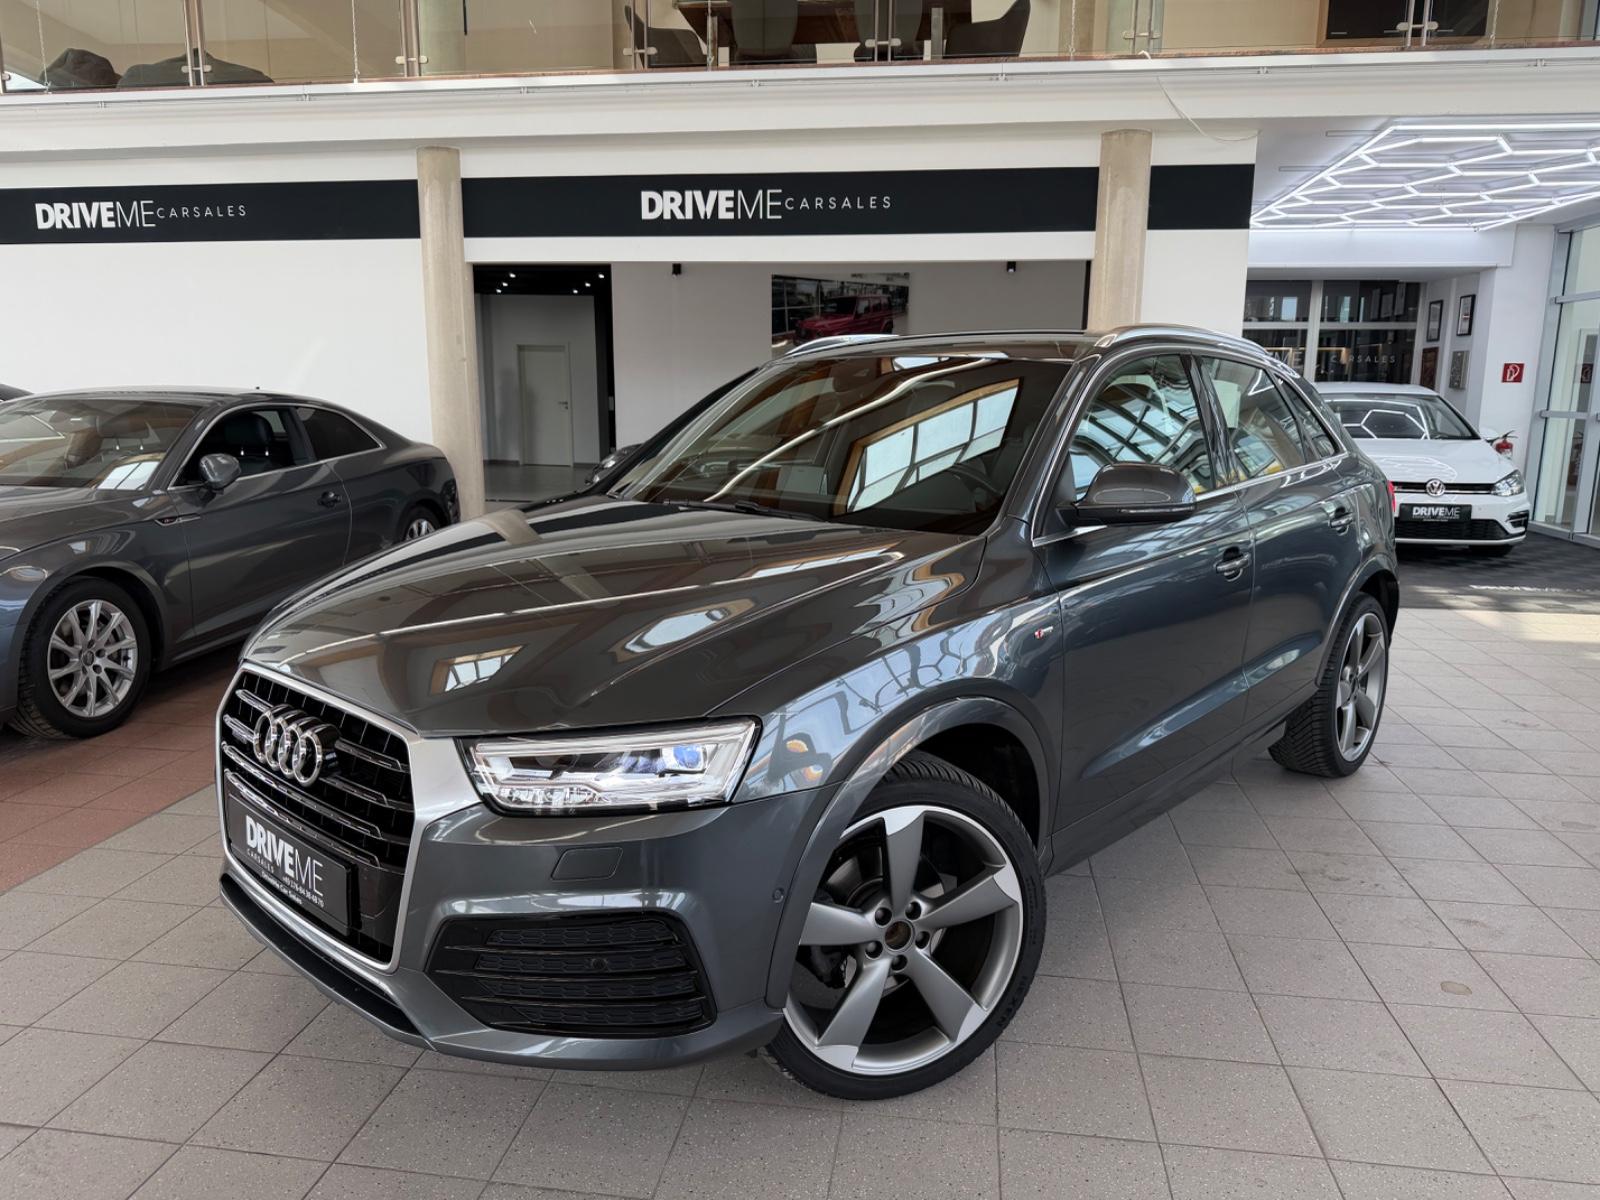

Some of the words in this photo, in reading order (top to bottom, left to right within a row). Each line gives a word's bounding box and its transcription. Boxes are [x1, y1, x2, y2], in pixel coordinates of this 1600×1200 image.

[35, 200, 156, 230] DRIVEME
[156, 204, 248, 218] CARSALES
[640, 188, 783, 220] DRIVEME
[785, 195, 892, 210] CARSALES
[1412, 506, 1461, 517] DRIVEME
[245, 815, 324, 897] DRIVEME
